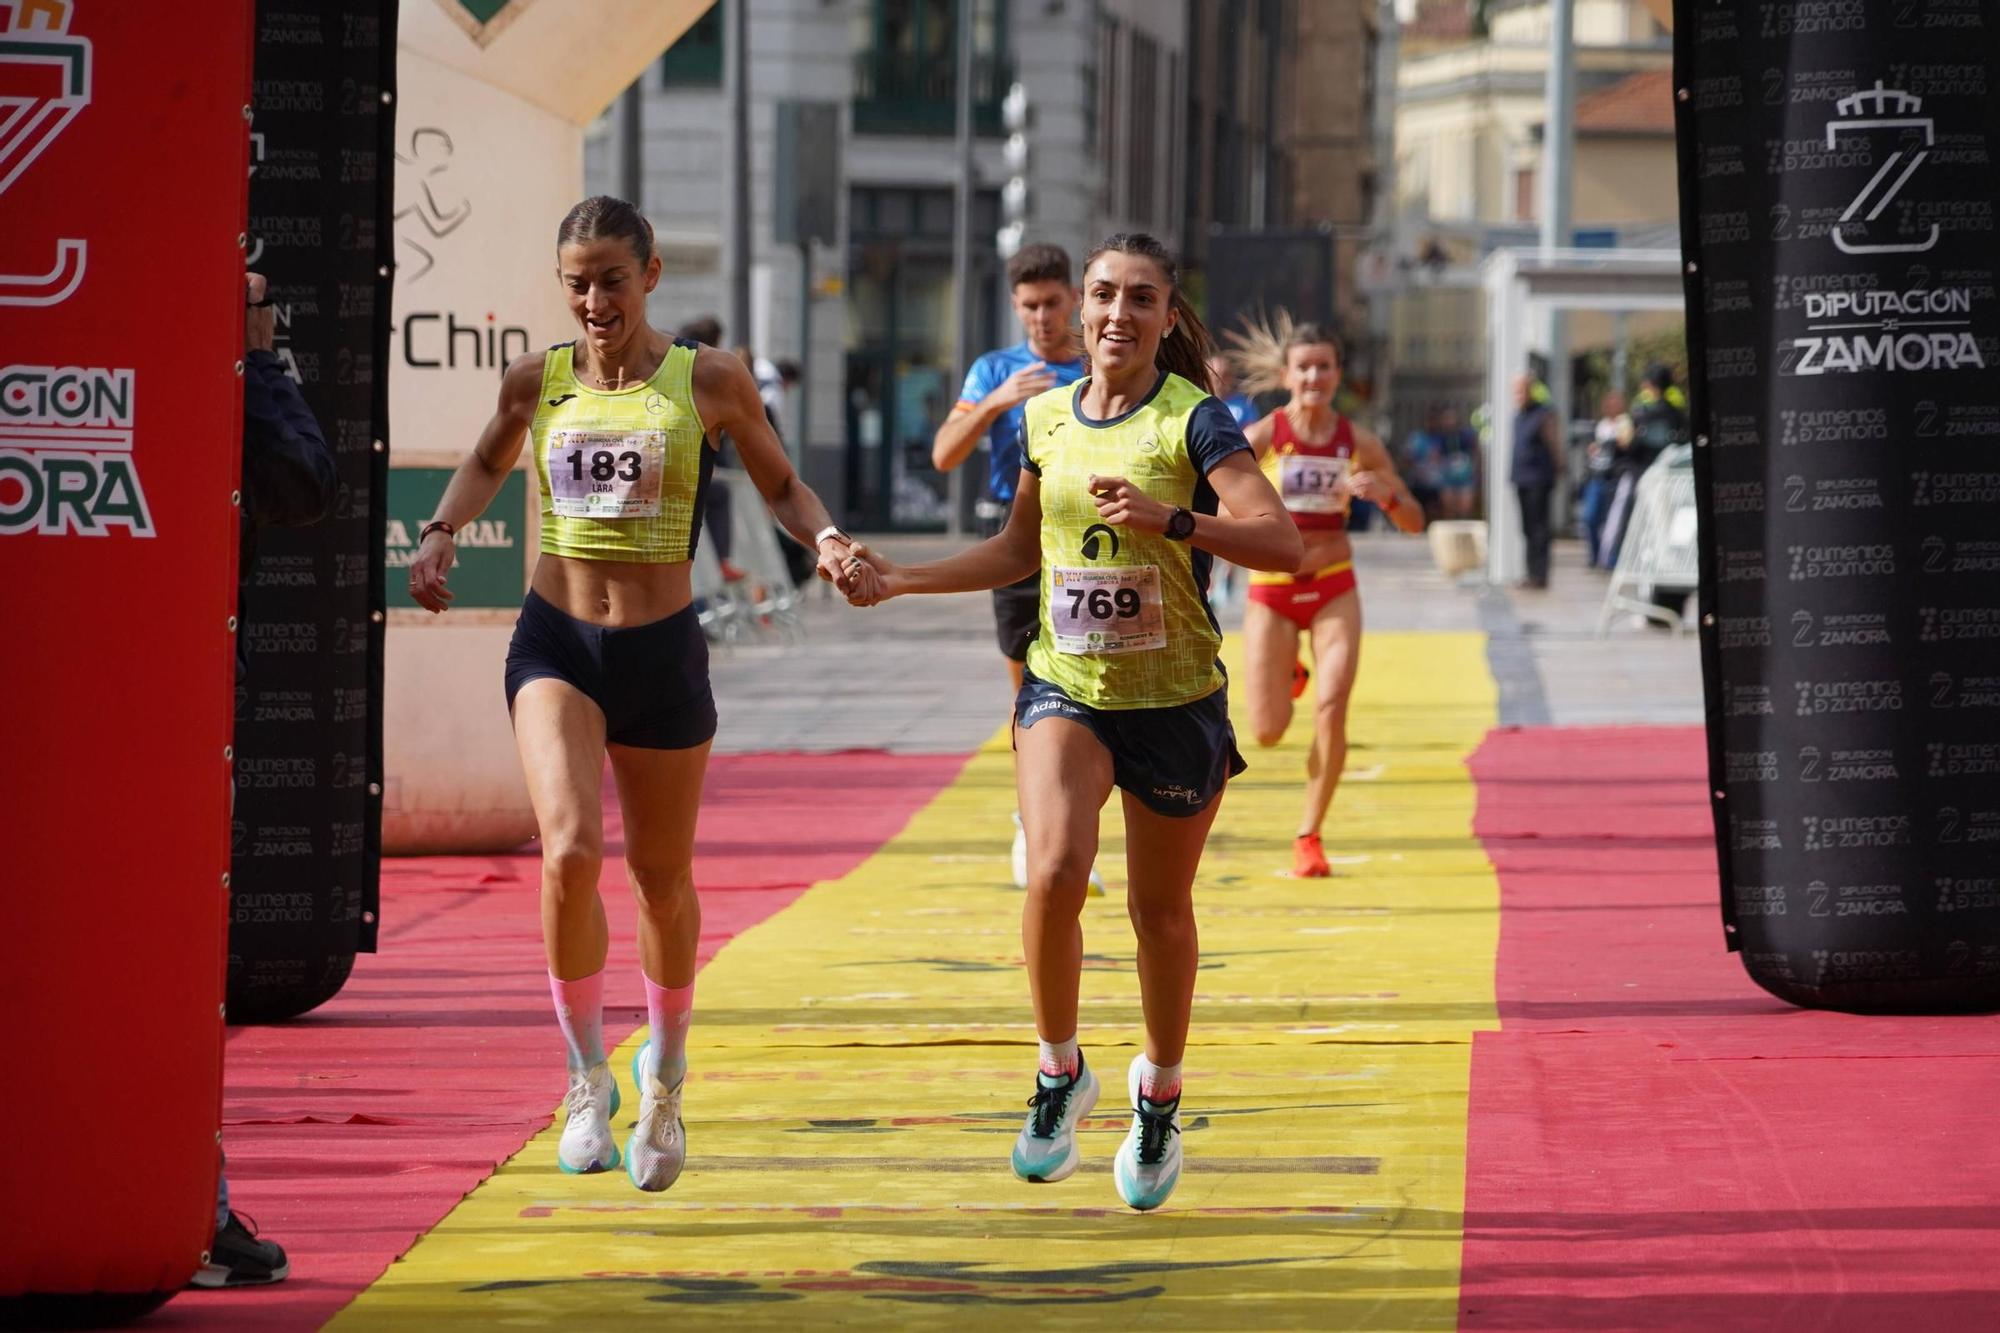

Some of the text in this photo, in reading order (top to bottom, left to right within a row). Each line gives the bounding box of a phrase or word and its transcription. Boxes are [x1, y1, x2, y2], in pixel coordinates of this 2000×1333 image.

[392, 311, 529, 380] Chip
[1793, 331, 1986, 376] ZAMORA
[567, 450, 642, 482] 183
[1296, 470, 1337, 488] 137
[592, 483, 613, 493] LARA
[1066, 588, 1141, 620] 769
